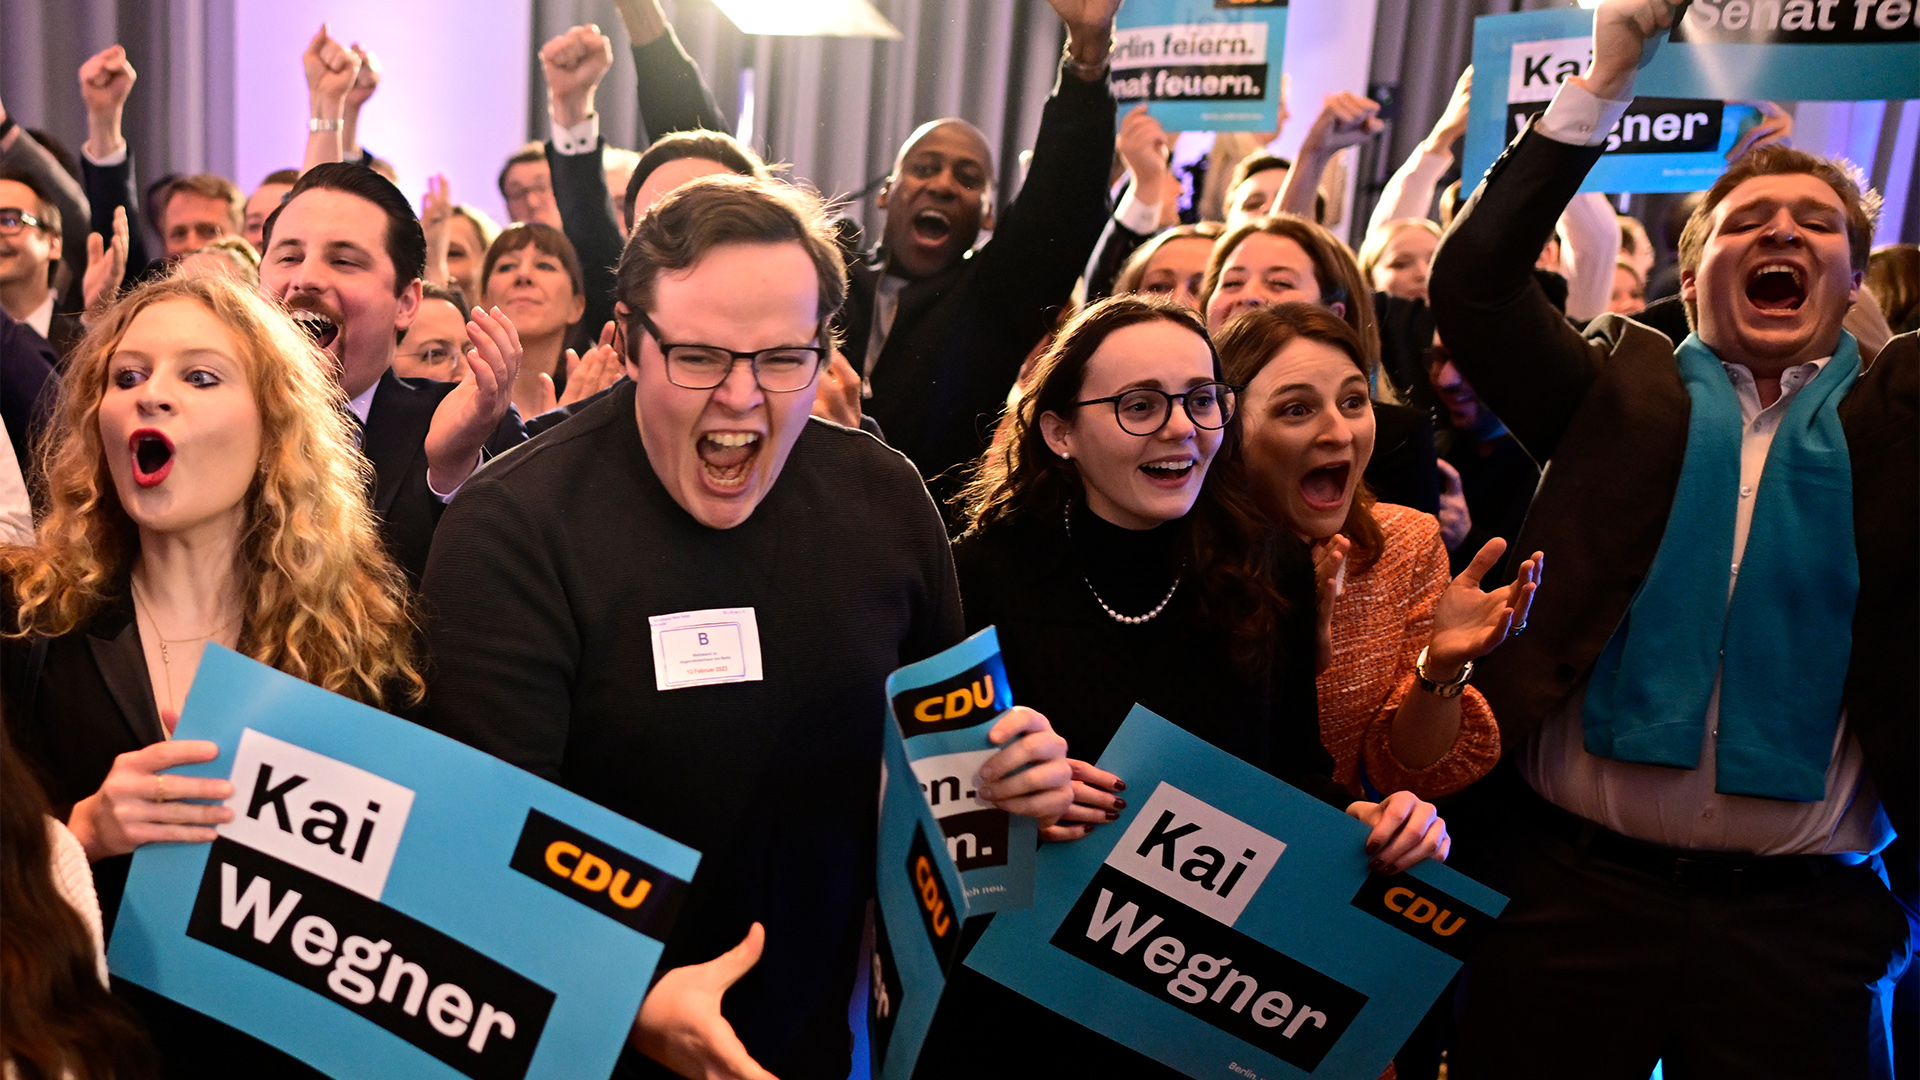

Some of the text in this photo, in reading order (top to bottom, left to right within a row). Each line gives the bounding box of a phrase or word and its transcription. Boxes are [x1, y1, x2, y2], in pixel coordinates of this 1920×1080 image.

[1693, 0, 1920, 31] Senat fe
[1111, 32, 1254, 60] rlin feiern.
[1106, 70, 1261, 98] nat feuern.
[698, 632, 710, 646] B
[914, 674, 994, 723] CDU
[246, 762, 381, 863] Kai
[544, 840, 653, 910] CDU
[1135, 809, 1257, 899] Kai
[916, 855, 951, 939] CDU
[1383, 886, 1467, 937] CDU
[220, 861, 516, 1054] Wegner
[1085, 887, 1327, 1039] Wegner
